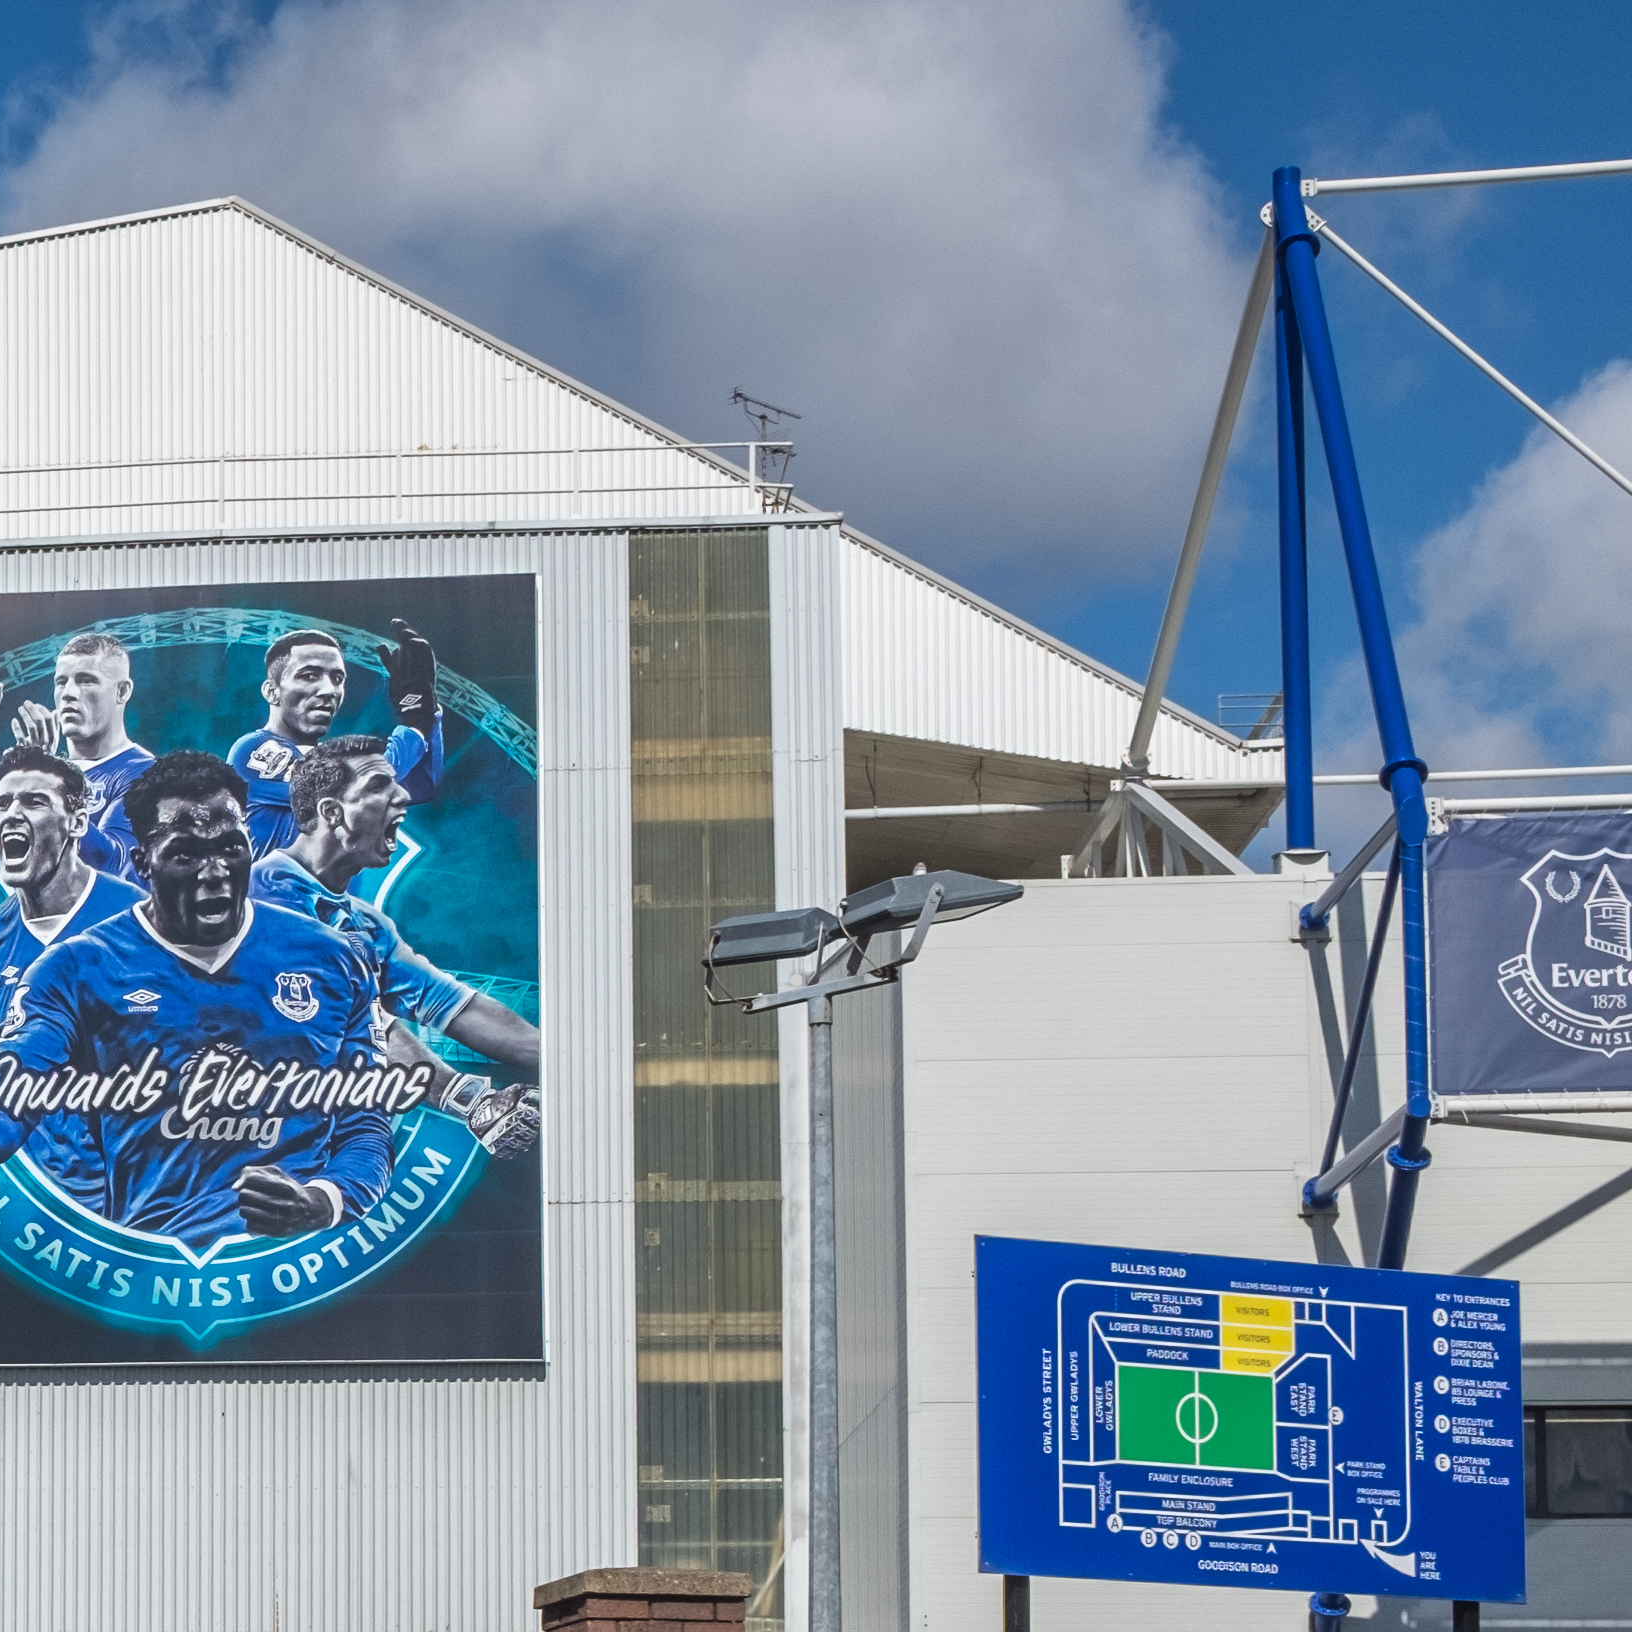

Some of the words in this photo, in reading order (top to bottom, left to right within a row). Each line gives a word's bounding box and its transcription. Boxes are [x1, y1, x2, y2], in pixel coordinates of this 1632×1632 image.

[1551, 963, 1632, 988] Evert
[1591, 994, 1627, 1009] 1878
[1511, 986, 1536, 1016] NIL
[1537, 1012, 1585, 1042] SATIS
[1590, 1031, 1632, 1045] NISI
[182, 1049, 430, 1121] Evertonians
[14, 1221, 135, 1298] SATIS
[151, 1273, 255, 1308] NISI
[271, 1145, 452, 1294] OPTIMUM
[1111, 1262, 1156, 1276] BULLENS
[1159, 1266, 1186, 1278] ROAD
[1131, 1291, 1160, 1303] UPPER
[1162, 1294, 1203, 1306] BULLENS
[1436, 1293, 1451, 1303] KEY
[1453, 1294, 1463, 1303] TO
[1152, 1305, 1182, 1315] STAND
[1235, 1306, 1269, 1317] VISITORS
[1437, 1311, 1445, 1324] A
[1109, 1322, 1140, 1333] LOWER
[1142, 1324, 1183, 1337] BULLENS
[1185, 1327, 1213, 1339] STAND
[1457, 1321, 1478, 1330] ALEX
[1480, 1323, 1506, 1332] YOUNG
[1237, 1333, 1271, 1344] VISITORS
[1147, 1349, 1188, 1360] PADDOCK
[1451, 1349, 1492, 1360] SPONSORS
[1237, 1357, 1271, 1368] VISITORS
[1472, 1360, 1494, 1369] DEAN
[1043, 1349, 1052, 1391] STREET
[1070, 1351, 1078, 1403] GWLADYS
[1438, 1379, 1446, 1391] C
[1290, 1385, 1298, 1414] EAST
[1464, 1388, 1495, 1398] LOUNGE
[1096, 1387, 1104, 1423] LOWER
[1105, 1381, 1114, 1431] GWLADYS
[1299, 1383, 1307, 1417] STAND
[1307, 1385, 1316, 1415] PARK
[1415, 1382, 1424, 1427] WALTON
[1043, 1396, 1053, 1454] GWLADYS
[1070, 1404, 1078, 1440] UPPER
[1438, 1418, 1446, 1430] D
[1452, 1417, 1494, 1428] EXECUTIVE
[1452, 1427, 1477, 1436] BOXES
[1415, 1430, 1424, 1461] LANE
[1471, 1437, 1514, 1448] BRASSERIE
[1291, 1438, 1299, 1467] WEST
[1308, 1439, 1316, 1467] PARK
[1438, 1457, 1447, 1469] E
[1453, 1456, 1490, 1466] CAPTAINS
[1453, 1465, 1477, 1474] TABLE
[1148, 1472, 1180, 1485] FAMILY
[1182, 1475, 1233, 1487] ENCLOSURE
[1453, 1475, 1487, 1484] PEOPLES
[1489, 1477, 1510, 1486] CLUB
[1162, 1500, 1185, 1510] MAIN
[1187, 1501, 1216, 1511] STAND
[1110, 1517, 1120, 1529] A
[1157, 1516, 1174, 1526] TOP
[1176, 1517, 1218, 1528] BALCONY
[1145, 1533, 1153, 1545] B
[1166, 1534, 1175, 1545] C
[1189, 1535, 1198, 1547] D
[1420, 1551, 1436, 1560] YOU
[1198, 1560, 1248, 1573] GOODISON
[1251, 1562, 1279, 1574] ROAD
[1420, 1561, 1436, 1569] ARE
[1420, 1571, 1441, 1580] HERE
